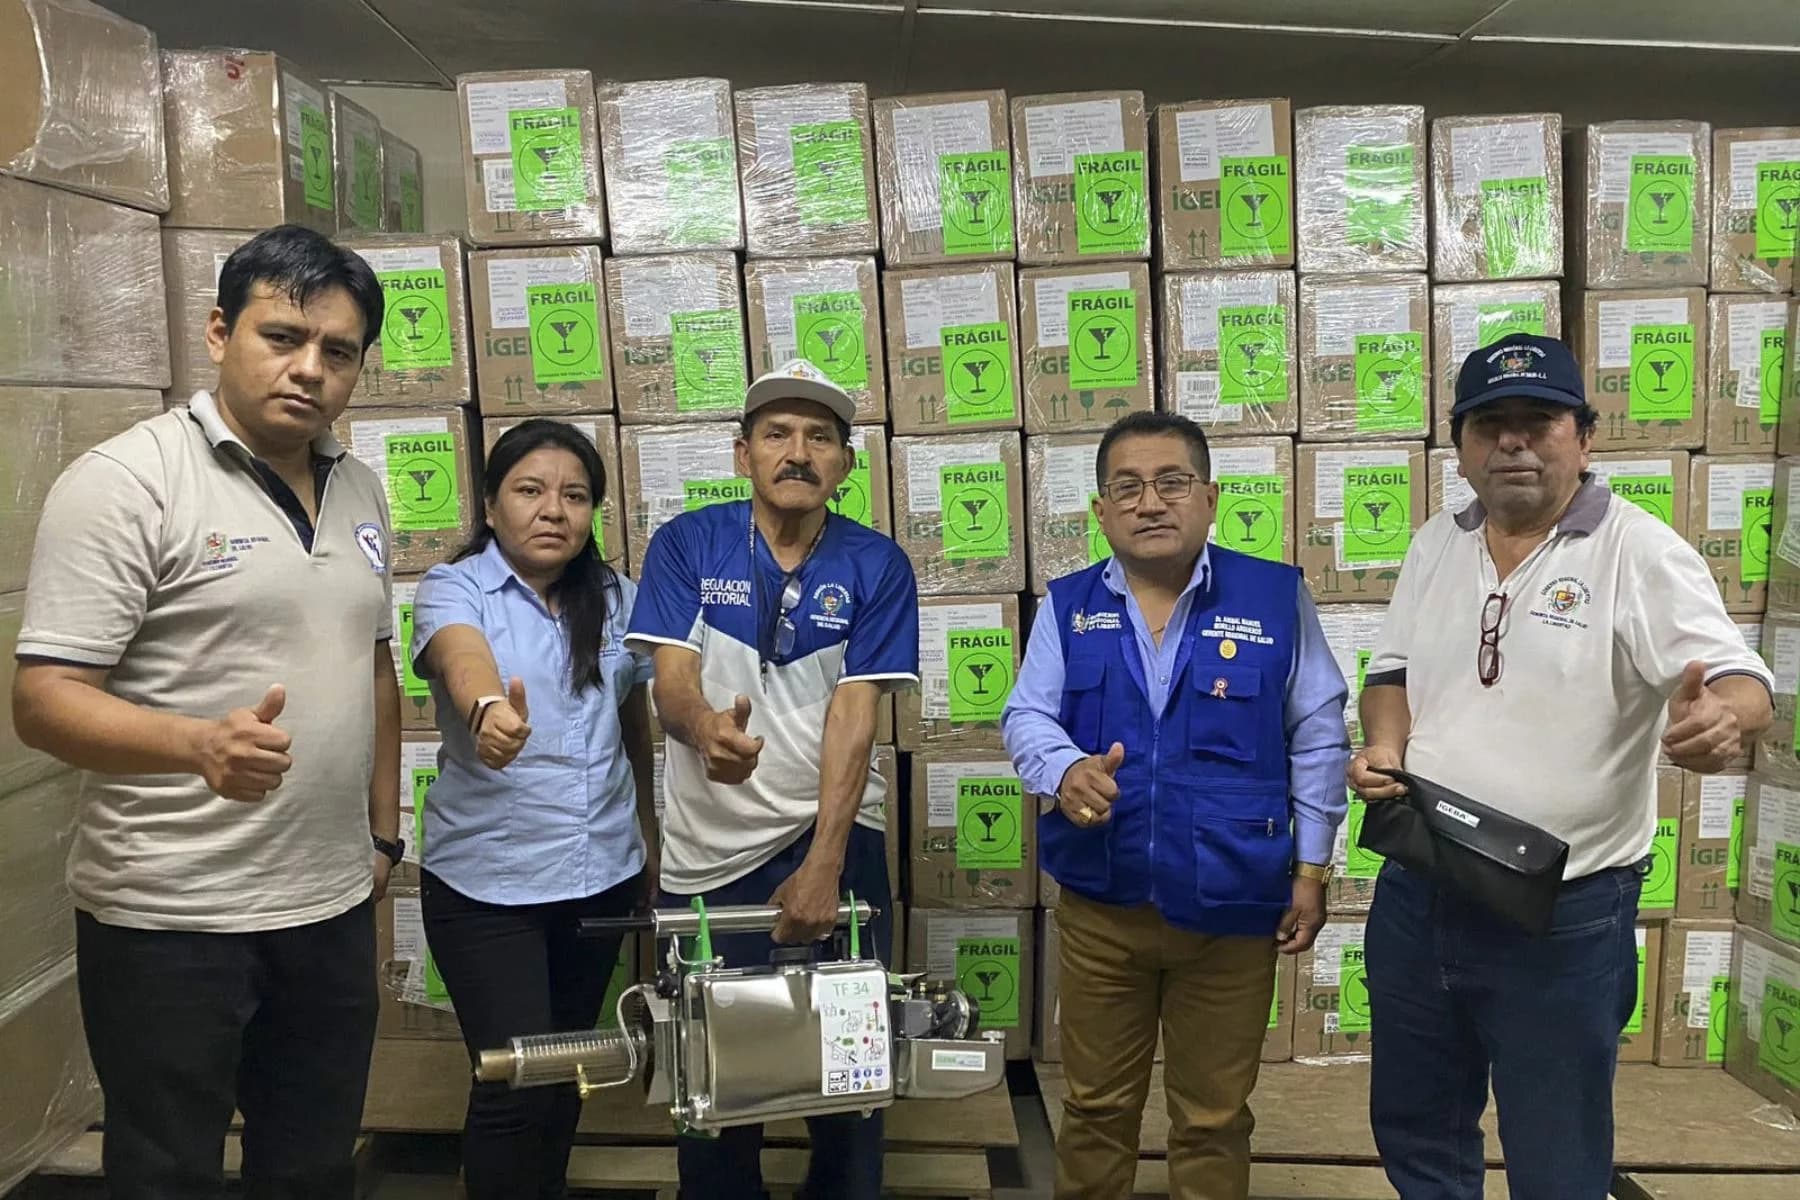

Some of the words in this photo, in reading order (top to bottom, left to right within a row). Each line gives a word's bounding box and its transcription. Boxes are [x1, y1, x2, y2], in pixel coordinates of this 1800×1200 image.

[1223, 161, 1287, 177] FRÁGIL
[1760, 169, 1800, 182] FRÁG
[1071, 297, 1134, 311] FRÁGIL
[960, 782, 1021, 798] FRÁGIL
